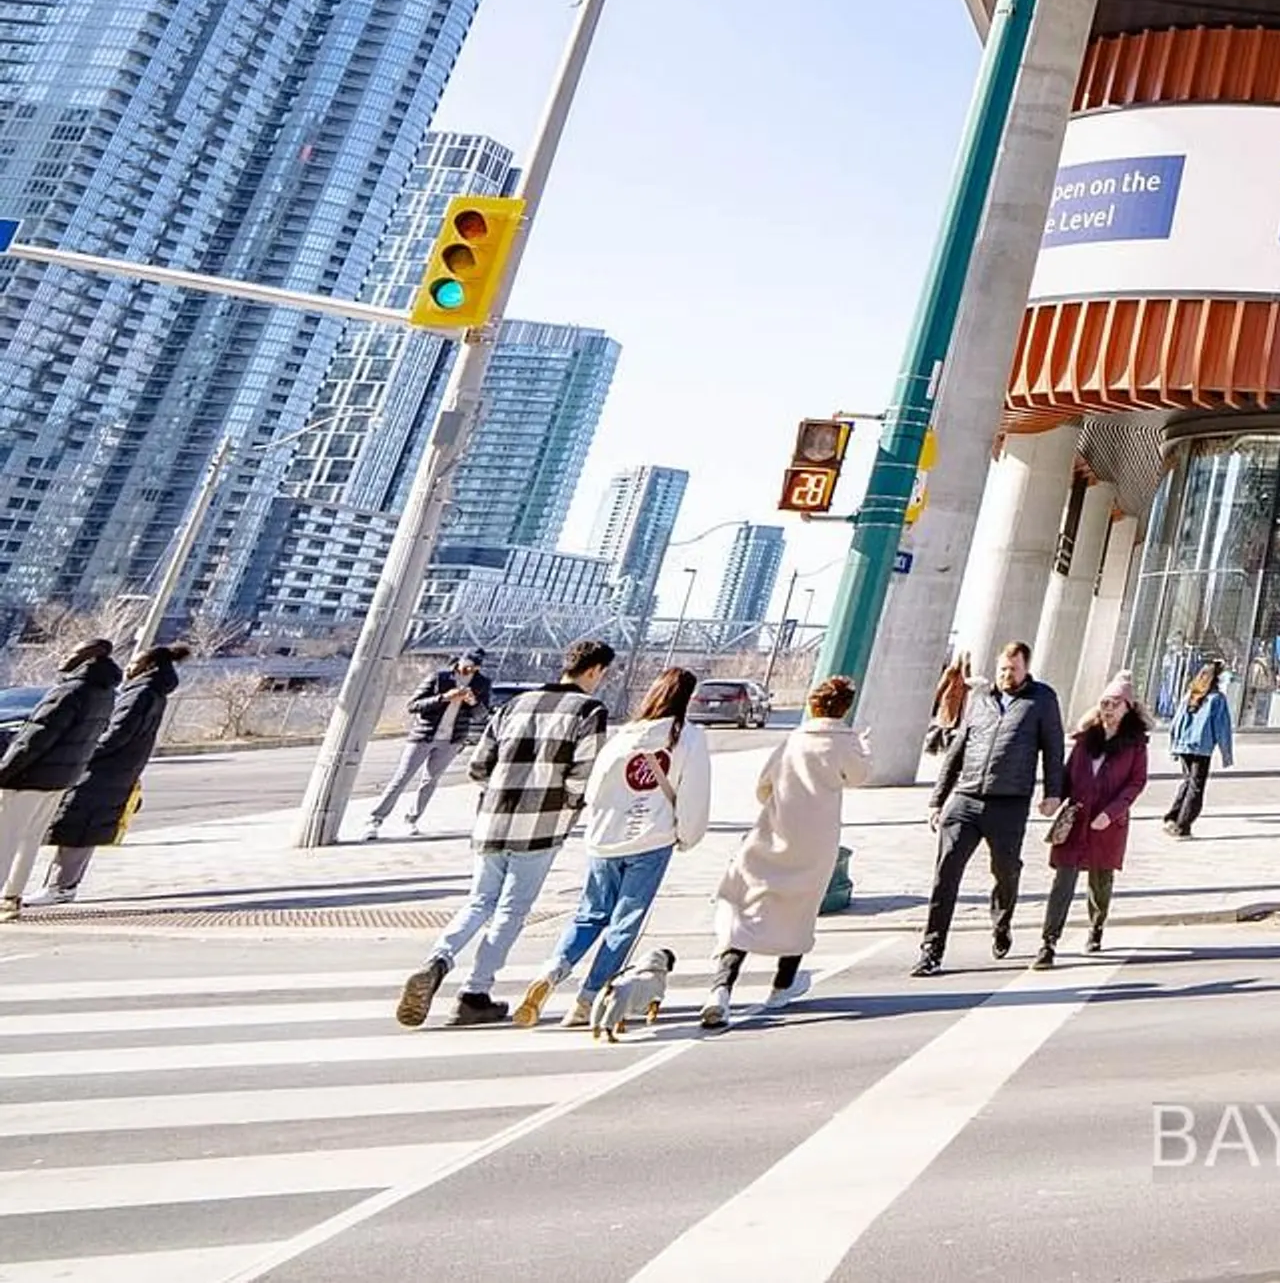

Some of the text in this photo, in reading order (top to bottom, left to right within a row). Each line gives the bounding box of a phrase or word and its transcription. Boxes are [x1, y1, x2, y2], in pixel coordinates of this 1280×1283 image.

[1050, 170, 1162, 207] pen on the
[1059, 204, 1116, 231] Level
[791, 473, 828, 507] 28
